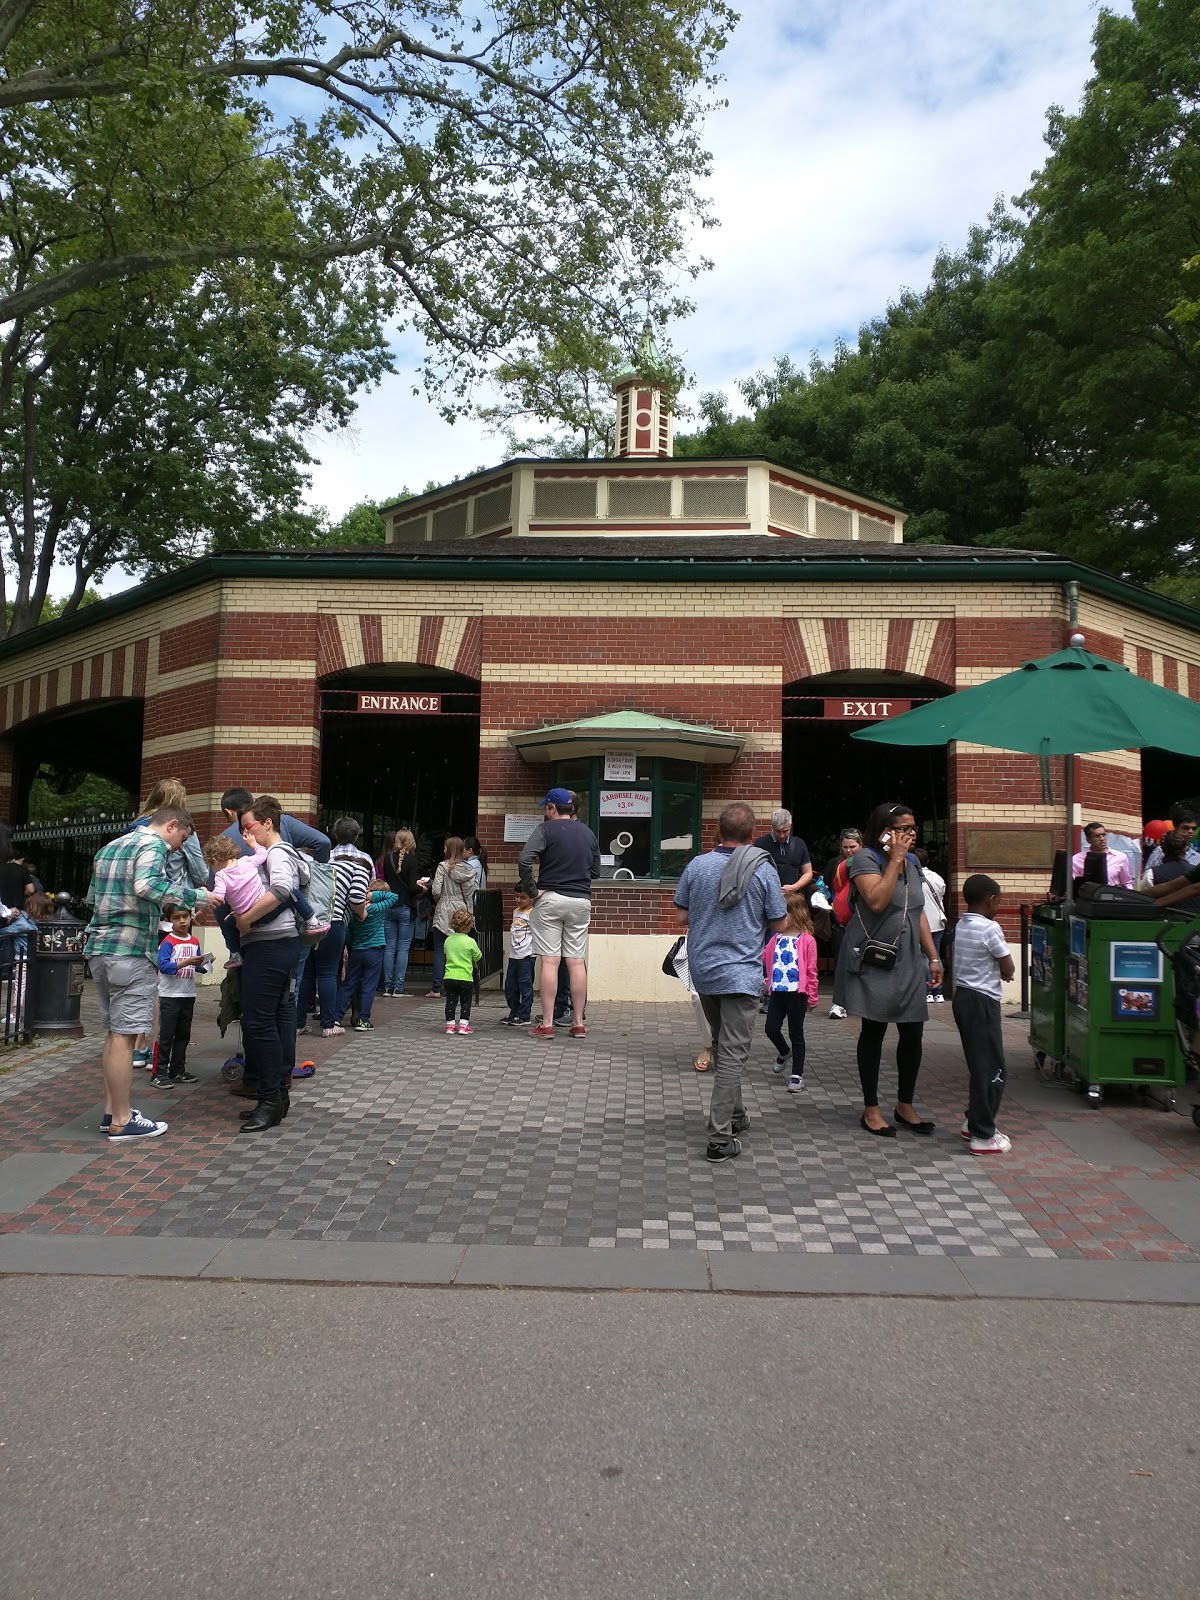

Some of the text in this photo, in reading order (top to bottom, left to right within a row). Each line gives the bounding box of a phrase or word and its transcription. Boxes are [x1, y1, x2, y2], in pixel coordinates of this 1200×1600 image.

[360, 696, 438, 710] ENTRANCE
[842, 702, 892, 716] EXIT
[602, 793, 650, 802] CAROUSEL RIDE
